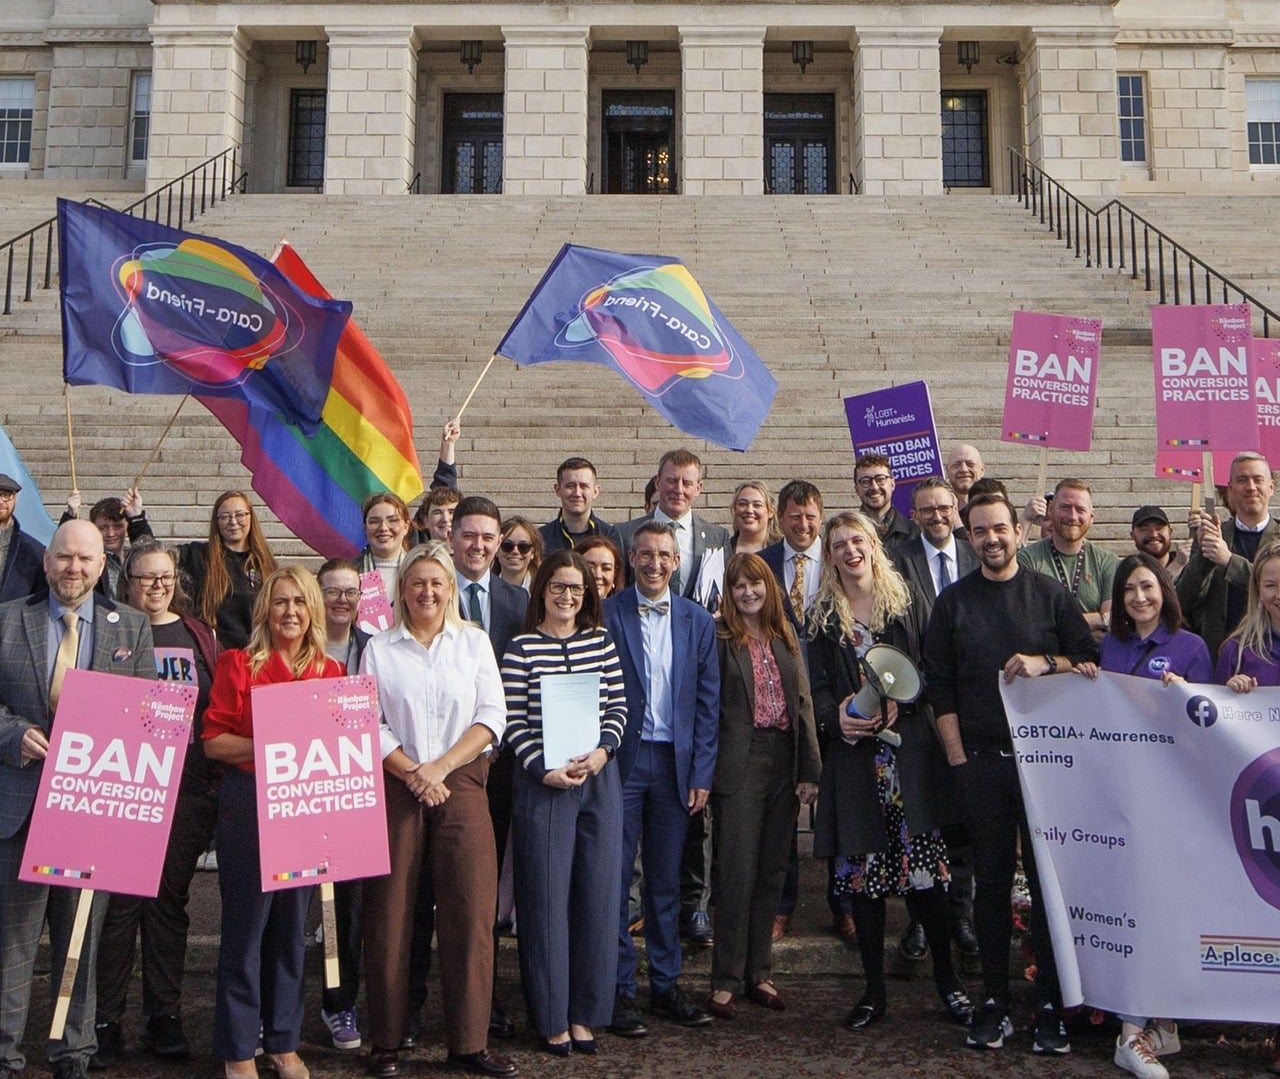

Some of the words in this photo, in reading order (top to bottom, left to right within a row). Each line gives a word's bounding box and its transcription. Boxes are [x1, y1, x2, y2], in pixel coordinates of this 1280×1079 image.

[1015, 349, 1092, 384] BAN
[1161, 347, 1247, 376] BAN
[1013, 377, 1089, 394] CONVERSION
[1162, 377, 1248, 389] CONVERSION
[1012, 387, 1089, 407] PRACTICES
[1162, 389, 1250, 403] PRACTICES
[876, 414, 916, 427] Humanists
[888, 443, 904, 454] TO
[905, 437, 931, 451] BAN
[889, 450, 935, 466] ERSION
[892, 463, 933, 479] CTICES
[337, 694, 370, 704] Rainbow
[343, 702, 370, 711] Project
[155, 710, 184, 721] Project
[1222, 707, 1262, 721] Here
[1011, 726, 1085, 740] LGBTQIA+
[1089, 727, 1175, 744] Awareness
[54, 731, 176, 787] BAN
[265, 733, 374, 784] BAN
[50, 775, 167, 804] CONVERSION
[267, 774, 375, 800] CONVERSION
[46, 792, 164, 823] PRACTICES
[268, 791, 377, 819] PRACTICES
[1071, 828, 1126, 848] Groups
[1069, 906, 1136, 928] Women's
[1089, 935, 1134, 958] Group
[1205, 946, 1218, 962] A
[1223, 945, 1274, 966] place
